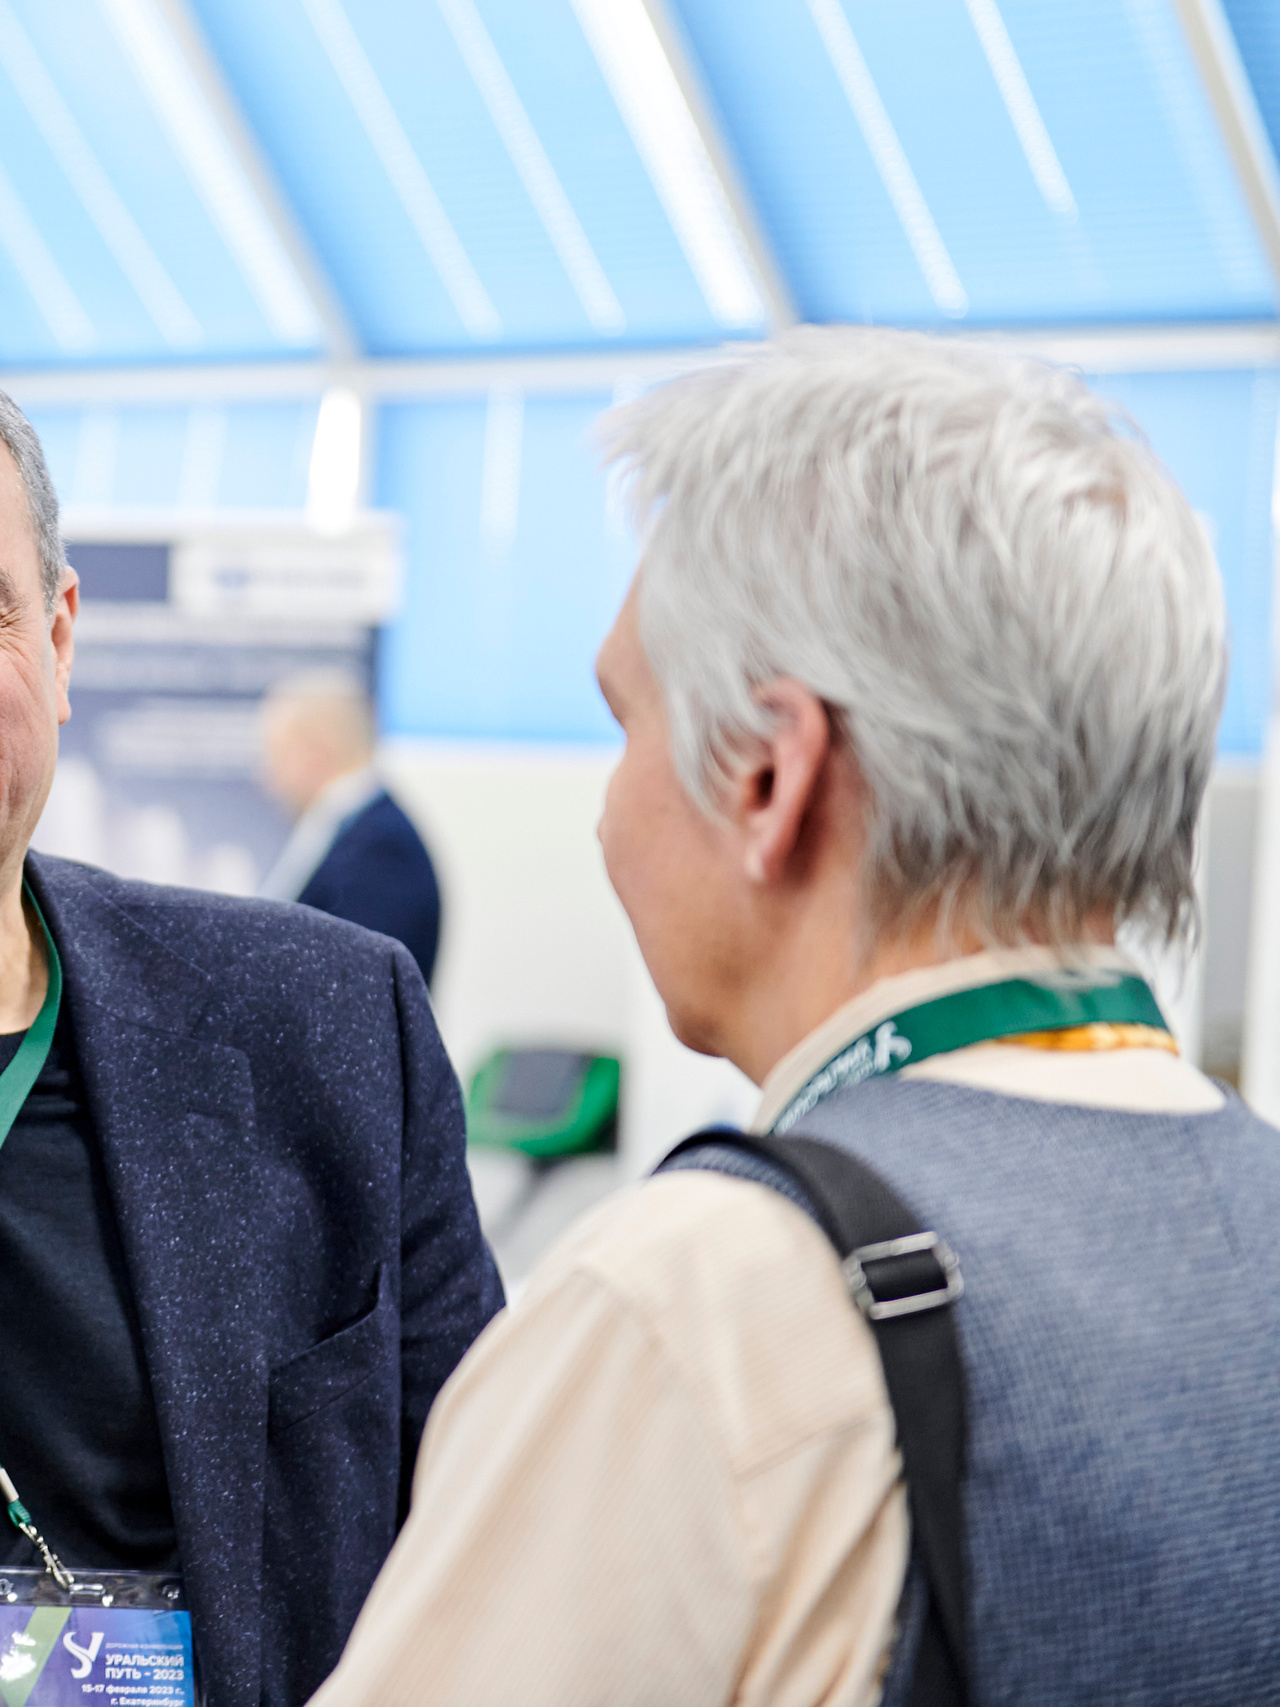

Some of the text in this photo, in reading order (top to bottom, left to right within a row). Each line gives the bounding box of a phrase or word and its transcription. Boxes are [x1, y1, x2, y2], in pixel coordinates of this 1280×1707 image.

[105, 1653, 184, 1667] УРАЛЬСКИЙ
[105, 1667, 142, 1679] ПУТЬ
[153, 1669, 184, 1680] 2023
[82, 1684, 105, 1693] 15-17
[106, 1684, 148, 1694] февраля
[149, 1685, 174, 1694] 2023
[119, 1697, 185, 1707] Екатеринбург
